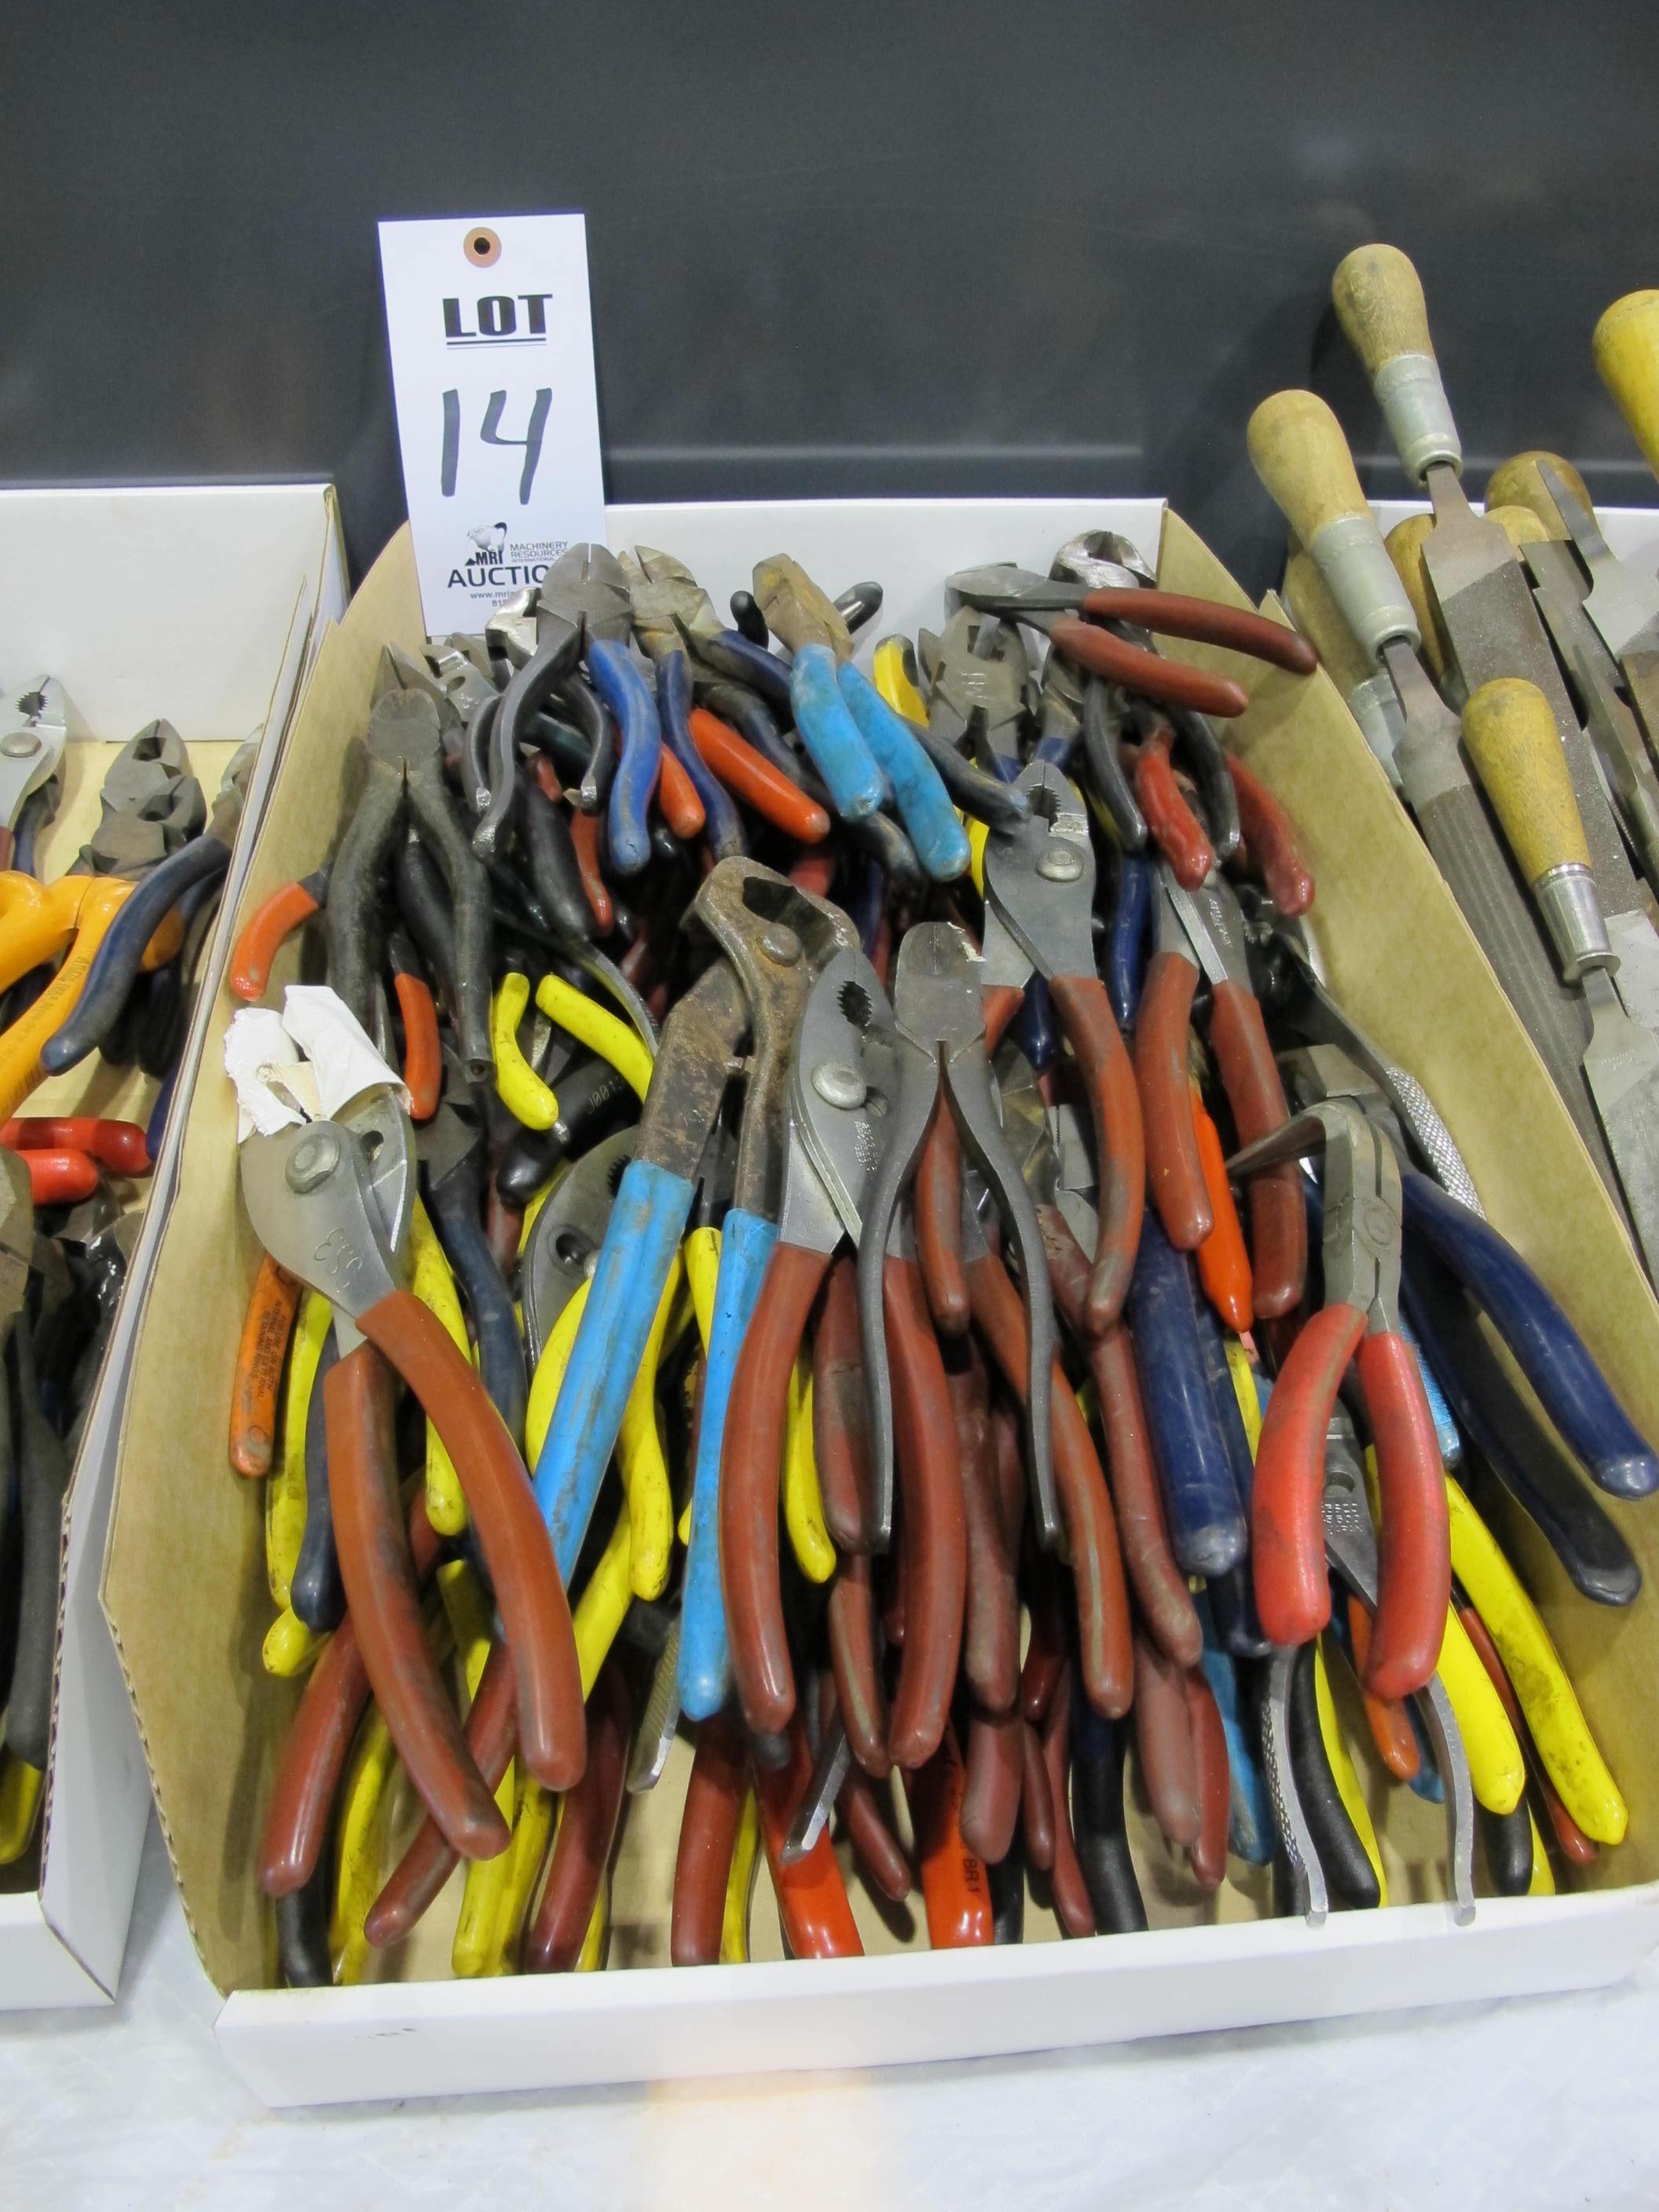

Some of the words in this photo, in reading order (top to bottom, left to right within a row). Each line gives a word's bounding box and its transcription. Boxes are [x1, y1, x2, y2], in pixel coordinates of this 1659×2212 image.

[442, 293, 553, 338] LOT
[441, 387, 553, 505] 14
[475, 549, 504, 566] MRI
[510, 541, 568, 551] MACHINERY
[447, 564, 550, 588] AUCTIO
